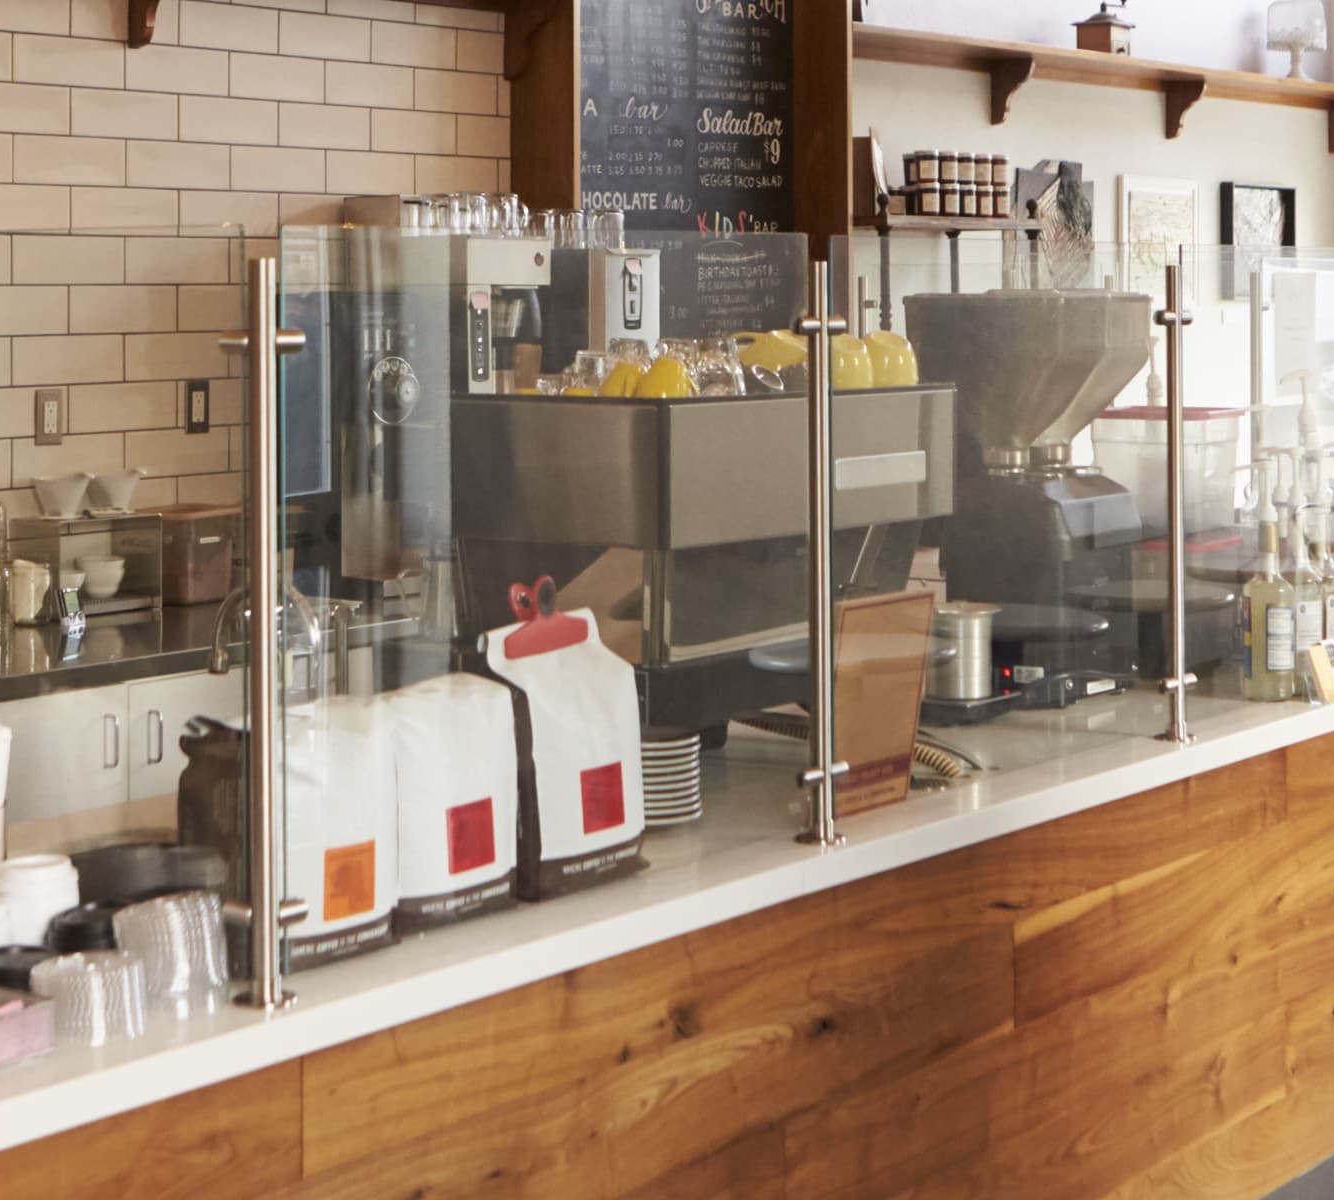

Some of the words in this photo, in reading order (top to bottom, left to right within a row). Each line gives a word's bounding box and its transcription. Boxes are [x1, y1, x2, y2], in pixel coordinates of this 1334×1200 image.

[722, 2, 760, 19] BAR
[583, 99, 598, 117] A
[621, 96, 667, 121] bar
[697, 107, 753, 135] Salad
[753, 111, 783, 136] Bar
[698, 141, 739, 153] CAPRESE
[699, 173, 732, 187] VEGGIE
[734, 175, 755, 188] TACO
[756, 175, 783, 188] SALAD
[582, 191, 657, 210] HOCOLATE
